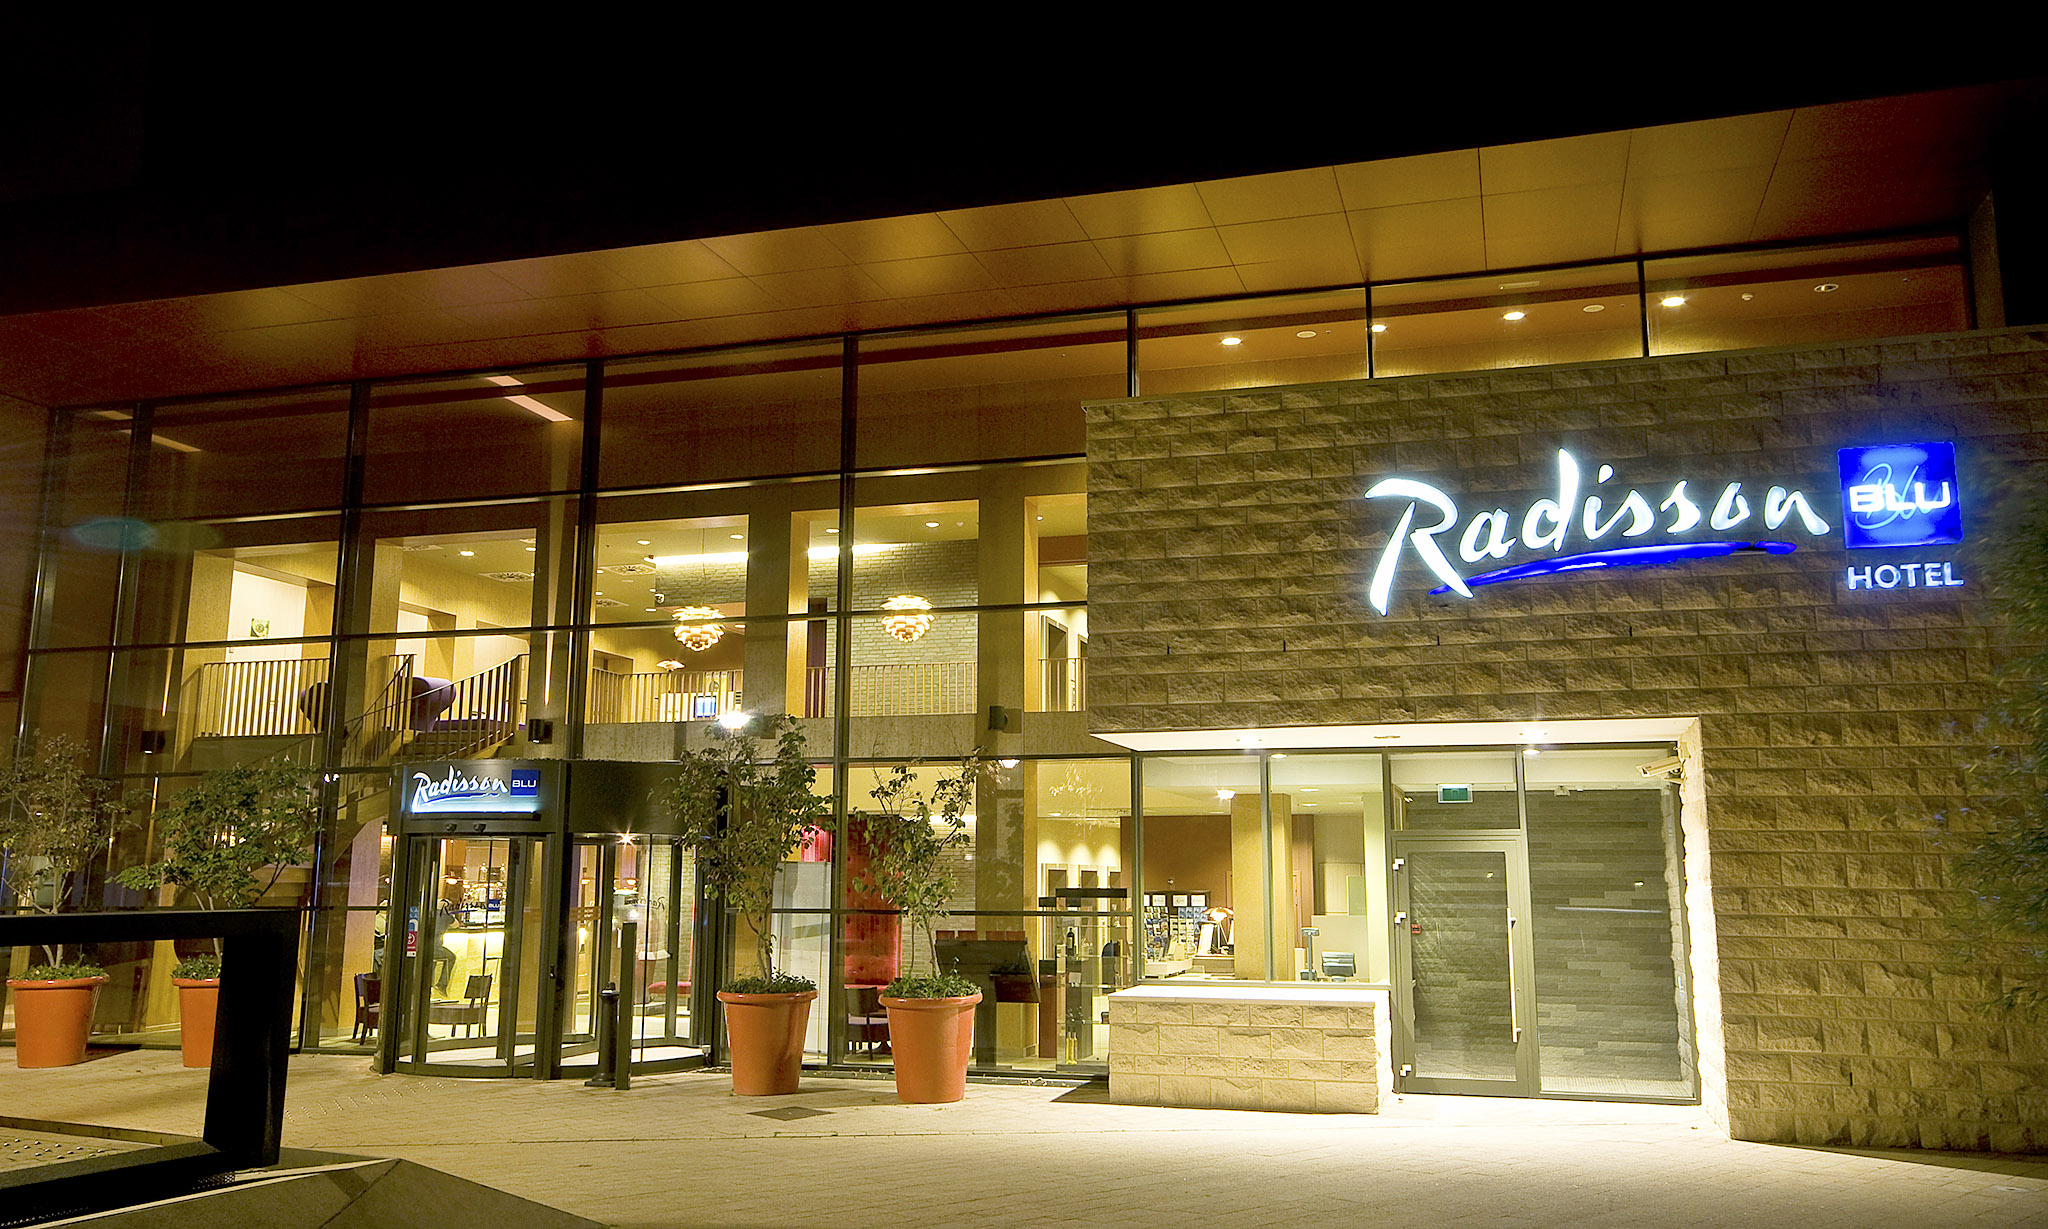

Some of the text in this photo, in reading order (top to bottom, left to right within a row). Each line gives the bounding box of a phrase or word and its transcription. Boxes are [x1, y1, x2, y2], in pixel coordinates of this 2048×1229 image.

[1365, 448, 1951, 617] Radisson BLU
[1847, 562, 1964, 590] HOTEL
[412, 766, 537, 811] Radisson BLU
